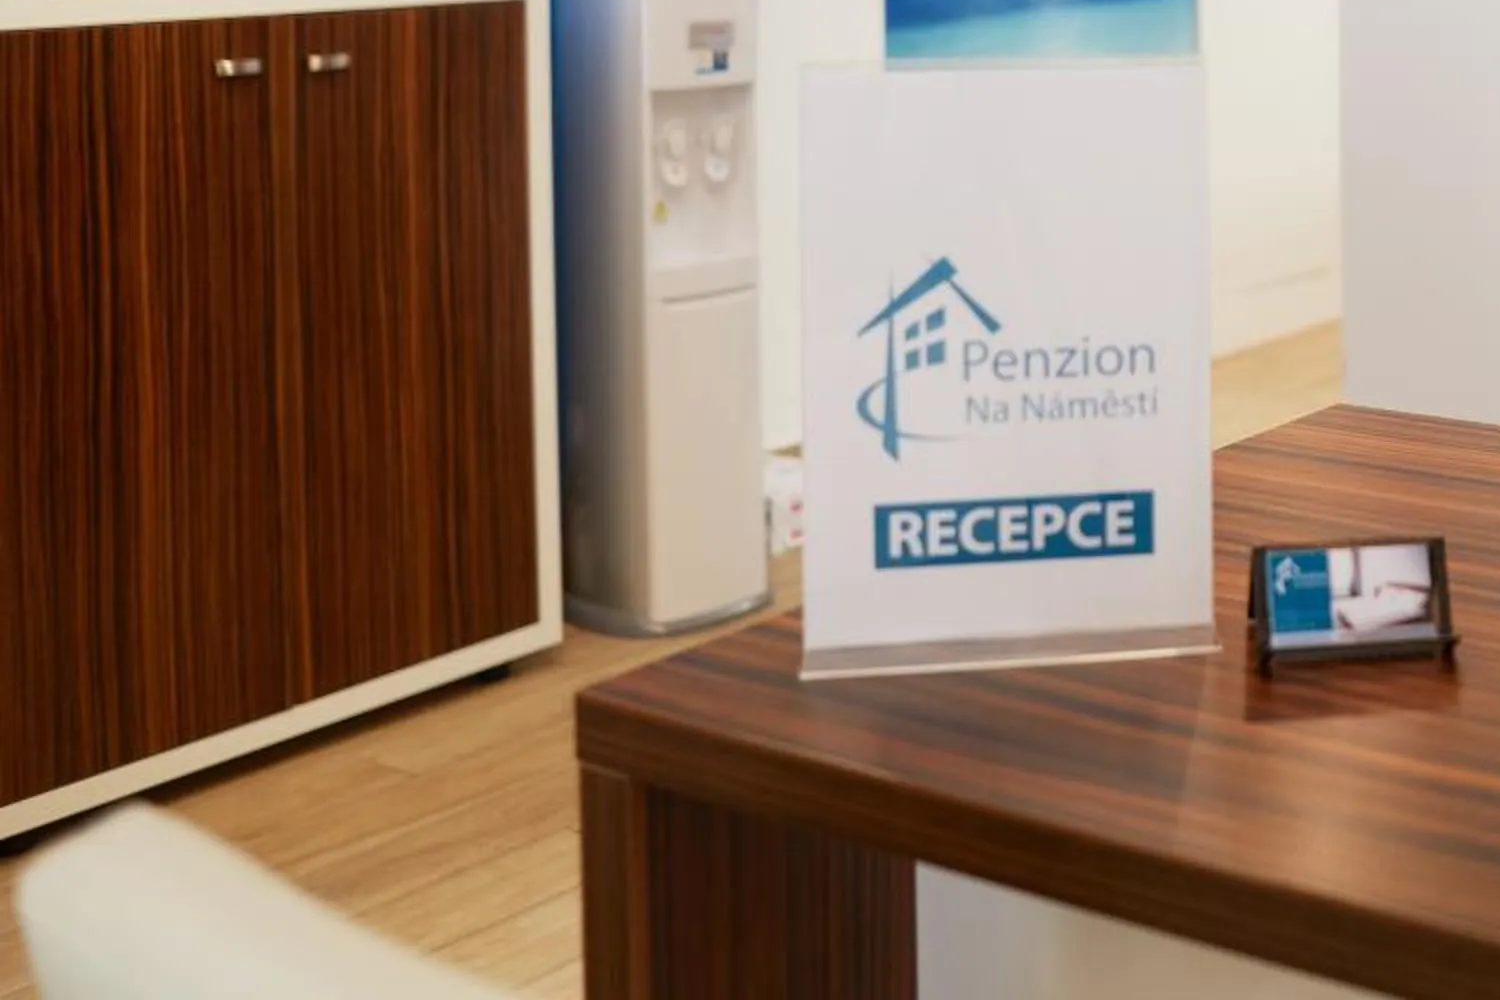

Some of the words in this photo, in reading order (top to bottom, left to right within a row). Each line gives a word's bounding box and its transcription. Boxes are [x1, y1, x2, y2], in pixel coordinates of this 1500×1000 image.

[962, 336, 1157, 382] Penzion
[966, 396, 1010, 424] Na
[1020, 386, 1159, 423] Náměstí
[887, 499, 1137, 558] RECEPCE
